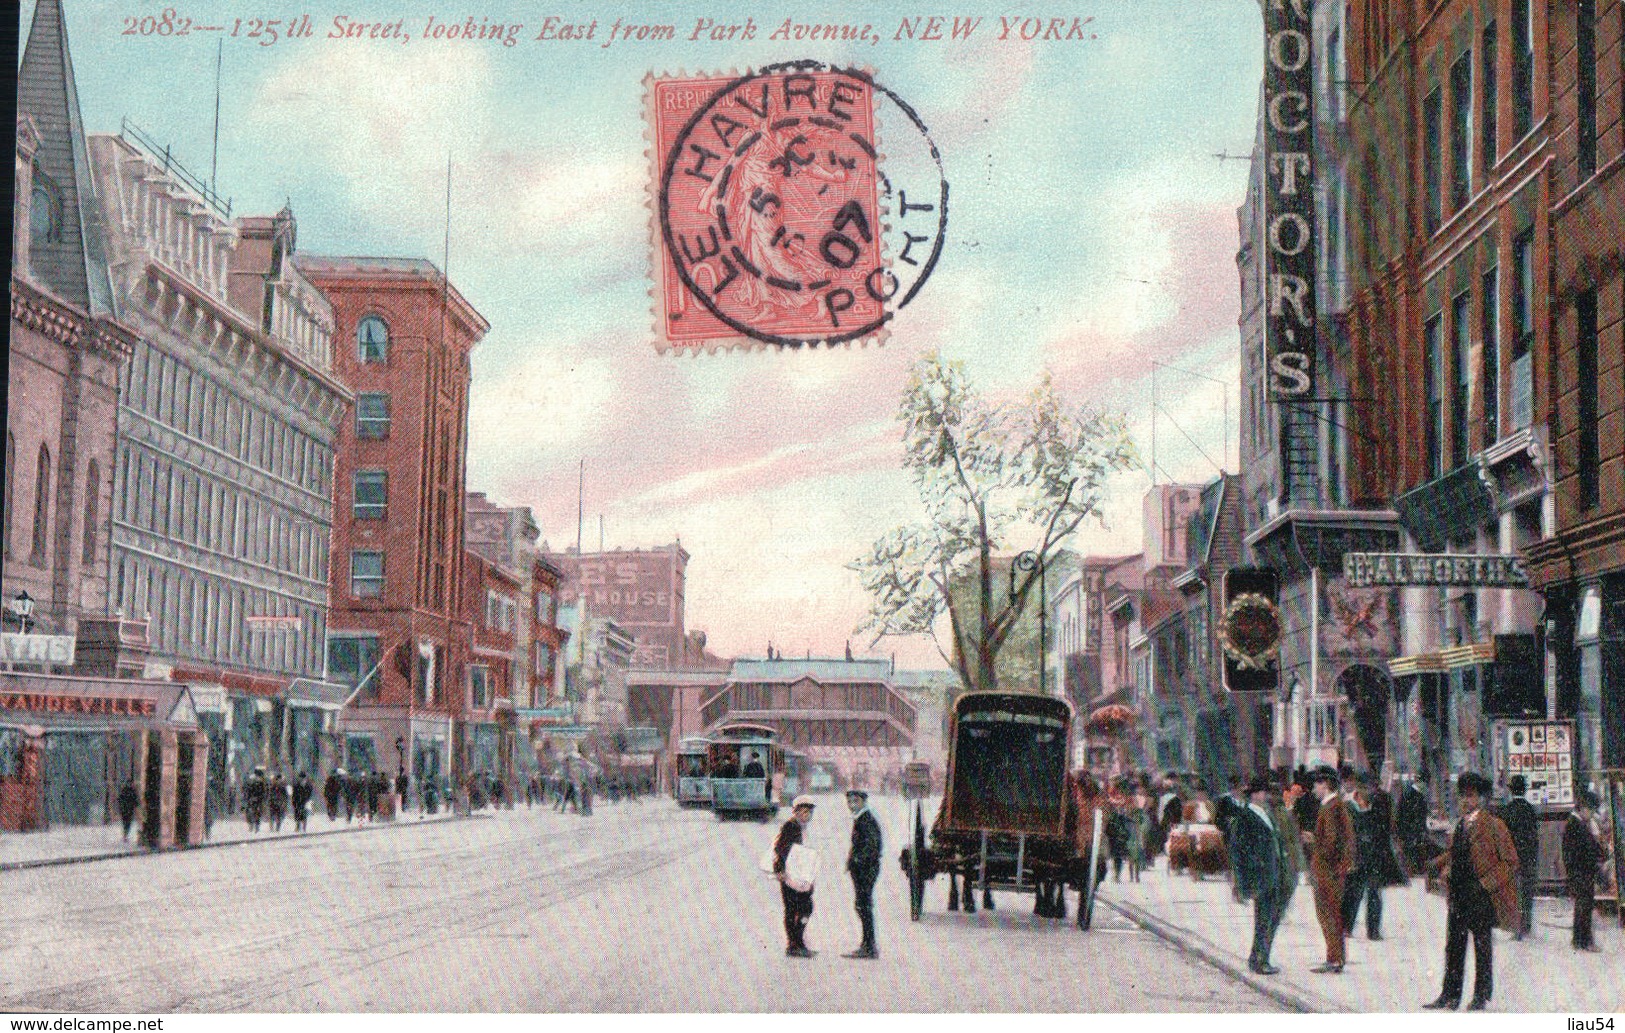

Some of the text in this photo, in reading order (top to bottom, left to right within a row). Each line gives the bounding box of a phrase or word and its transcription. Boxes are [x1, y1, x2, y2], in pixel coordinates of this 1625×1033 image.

[684, 74, 863, 183] HAVRE
[679, 225, 740, 295] LE
[819, 199, 873, 270] 07
